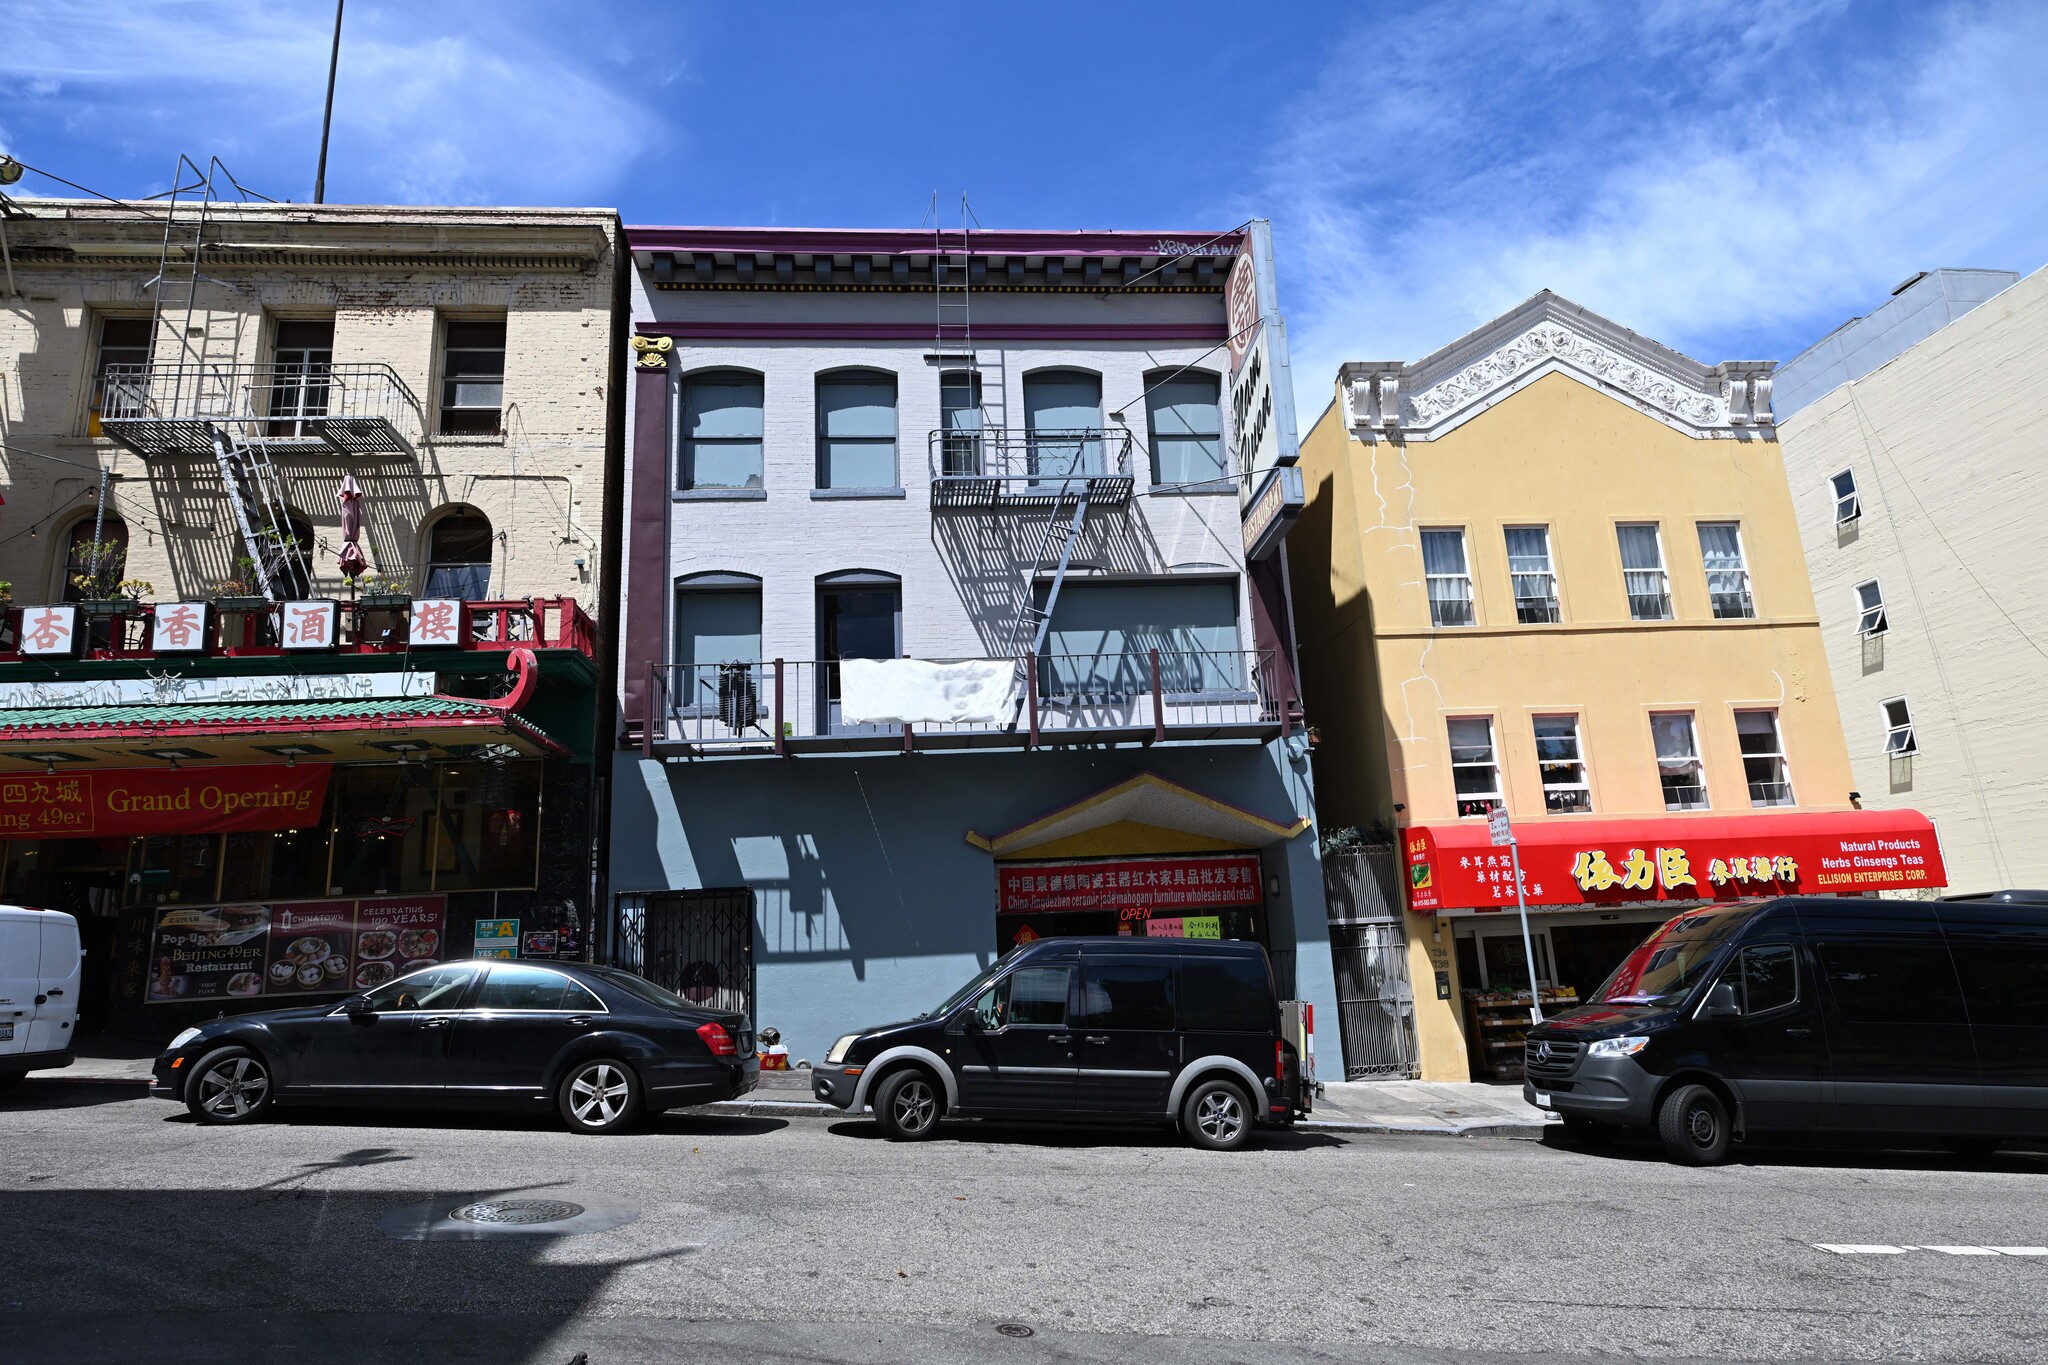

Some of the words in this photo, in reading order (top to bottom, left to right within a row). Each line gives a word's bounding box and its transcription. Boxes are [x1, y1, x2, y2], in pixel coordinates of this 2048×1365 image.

[1234, 346, 1261, 441] Nam
[1241, 384, 1272, 494] Yuen
[1243, 479, 1283, 548] RESTAURANT
[160, 606, 200, 647] 香
[286, 607, 330, 643] 酒
[107, 787, 191, 813] Grand
[199, 784, 313, 815] Opening
[37, 808, 85, 825] 49er
[1840, 840, 1876, 852] Natural
[1877, 839, 1921, 850] Products
[1821, 857, 1851, 869] Herbs
[1853, 856, 1898, 869] Ginsengs
[1900, 854, 1924, 865] Teas
[1008, 867, 1252, 892] 中国景德镇陶瓷玉器红木家具品批发零售
[1817, 872, 1852, 885] ELLISION
[1854, 870, 1904, 883] ENTERPRISES
[1905, 869, 1927, 881] CORP.
[1008, 895, 1029, 910] China
[1071, 892, 1099, 907] ceramic
[1099, 891, 1115, 908] jade
[1116, 889, 1153, 907] mahogany
[1154, 888, 1186, 904] furniture
[1186, 887, 1221, 902] wholesale
[1222, 885, 1236, 901] and
[1236, 884, 1255, 900] retail
[292, 914, 344, 923] CHINATOWN
[363, 906, 424, 916] CELEBRATING
[1120, 907, 1153, 921] OPEN
[371, 917, 388, 926] 100
[393, 913, 438, 924] YEARS!
[497, 921, 514, 937] A
[161, 932, 207, 946] Pop-Up
[1431, 948, 1448, 957] 736
[185, 960, 254, 973] Restaurant
[1432, 960, 1449, 969] 738
